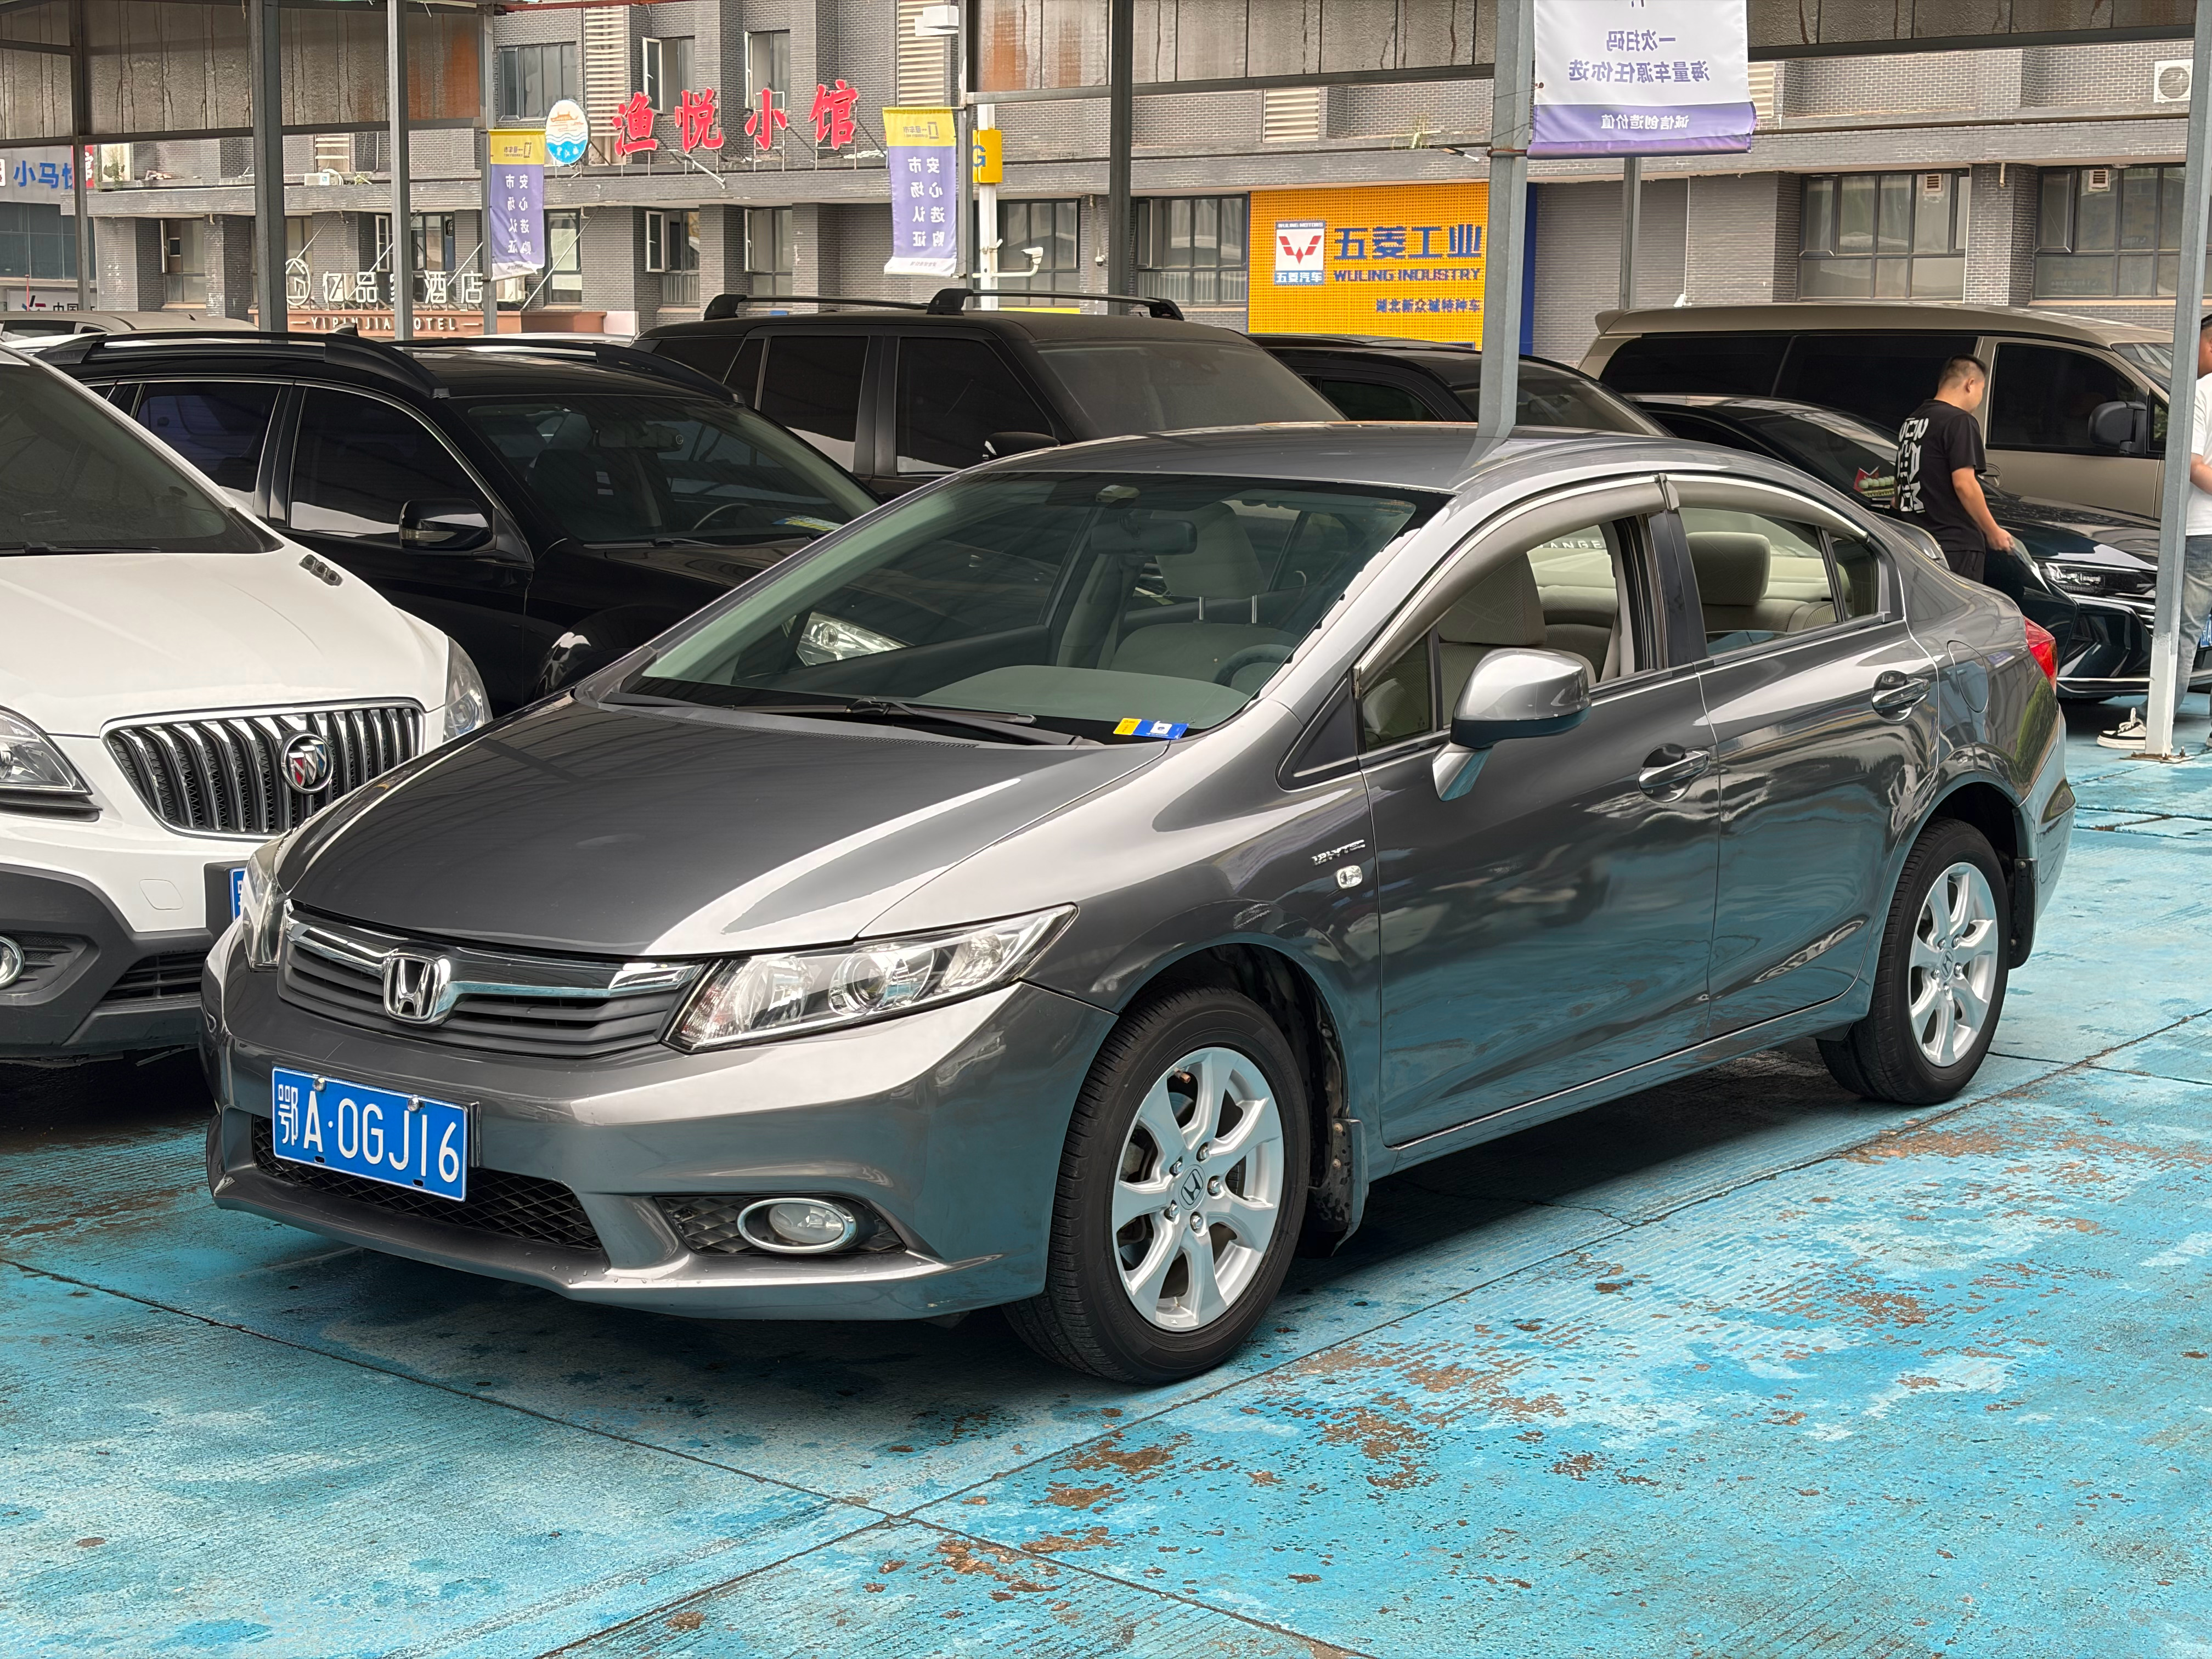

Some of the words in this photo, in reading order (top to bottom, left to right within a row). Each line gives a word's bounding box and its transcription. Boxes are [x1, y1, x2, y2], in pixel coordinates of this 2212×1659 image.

[612, 80, 859, 156] 渔悦小馆
[1334, 224, 1481, 260] 五菱工业
[1276, 272, 1323, 283] 五菱汽车
[1334, 269, 1395, 282] WULING
[1398, 268, 1481, 281] INDUSTRY
[323, 270, 483, 304] 亿品酒店
[365, 317, 391, 330] JIA
[413, 317, 455, 330] OTEL
[1537, 540, 1602, 549] ANGE
